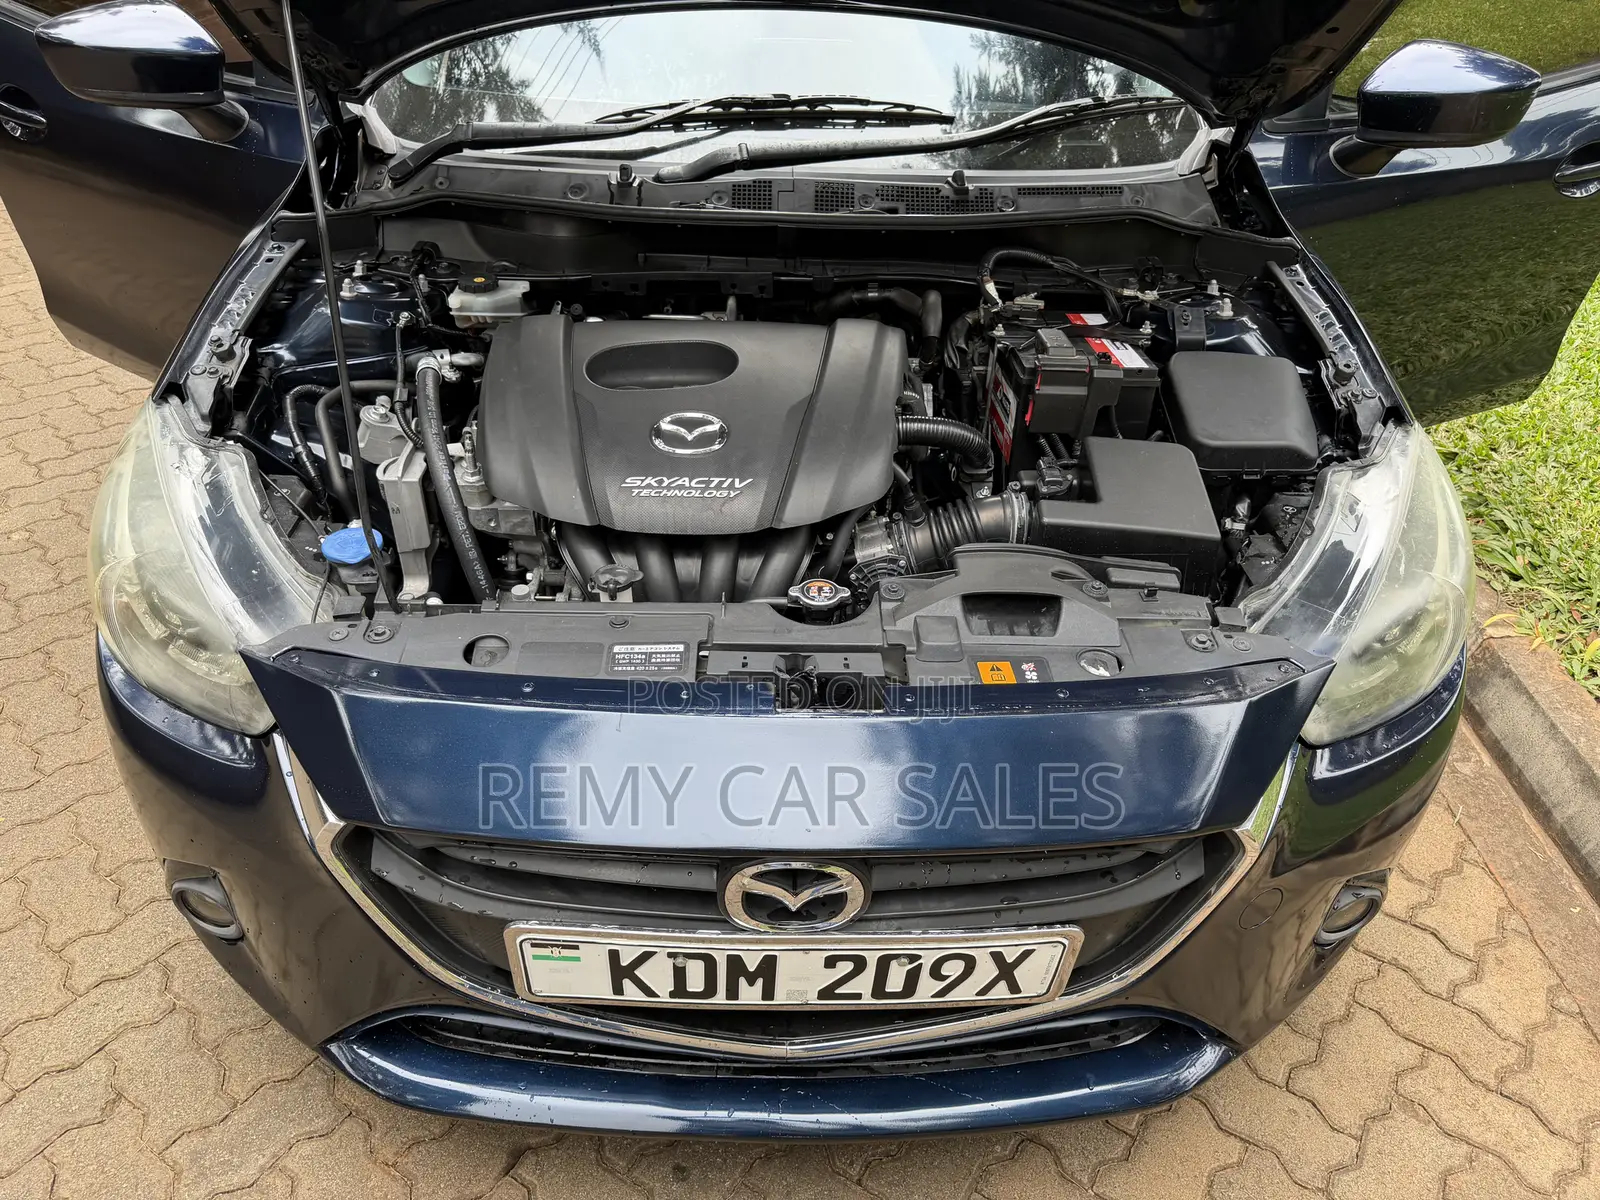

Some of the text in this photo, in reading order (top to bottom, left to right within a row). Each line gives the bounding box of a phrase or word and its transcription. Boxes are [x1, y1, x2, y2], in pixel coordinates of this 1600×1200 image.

[621, 476, 753, 488] SKYACTIV
[631, 489, 741, 498] TECHNOLOGY
[607, 948, 778, 1001] KDM
[817, 948, 1037, 1001] 209X
